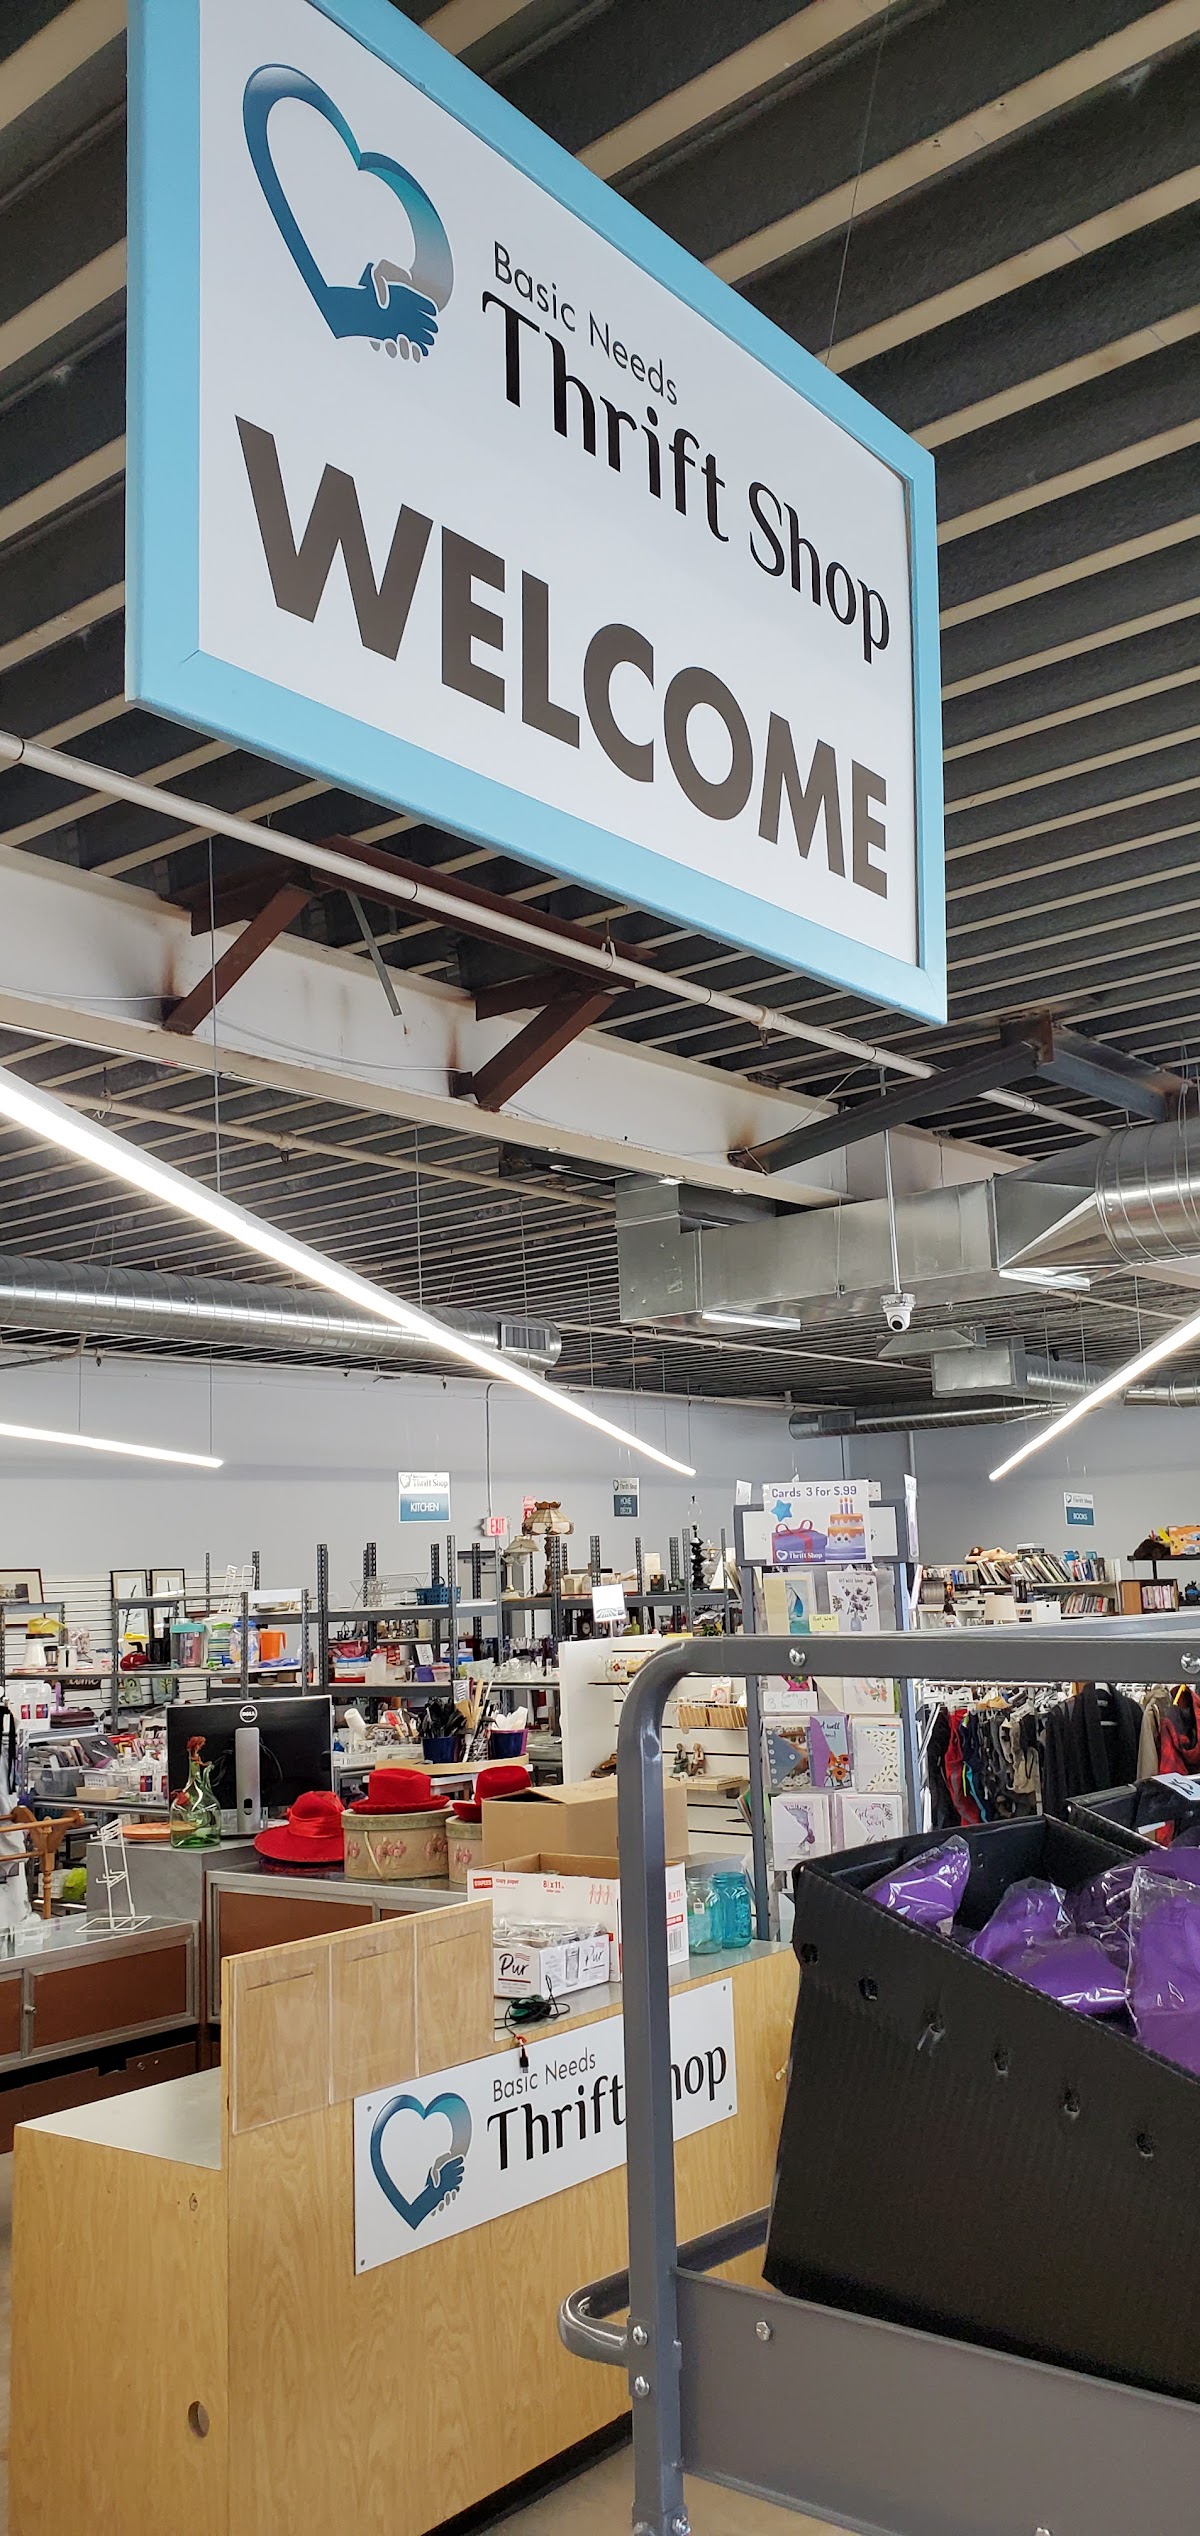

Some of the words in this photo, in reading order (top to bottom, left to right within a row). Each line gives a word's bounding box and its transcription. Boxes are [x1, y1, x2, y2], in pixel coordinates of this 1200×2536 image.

[494, 240, 576, 332] Basic
[589, 311, 679, 406] Needs
[482, 291, 730, 543] Thrift
[748, 481, 890, 665] Shop
[234, 414, 888, 899] WELCOME
[410, 1502, 440, 1512] KITCHEN
[772, 1487, 801, 1498] Cards
[806, 1487, 813, 1497] 3
[815, 1486, 831, 1496] for
[490, 1518, 505, 1534] EXIT
[499, 1953, 529, 1976] Pur
[493, 2073, 538, 2102] Basic
[545, 2047, 596, 2085] Needs
[487, 2074, 627, 2171] Thrift
